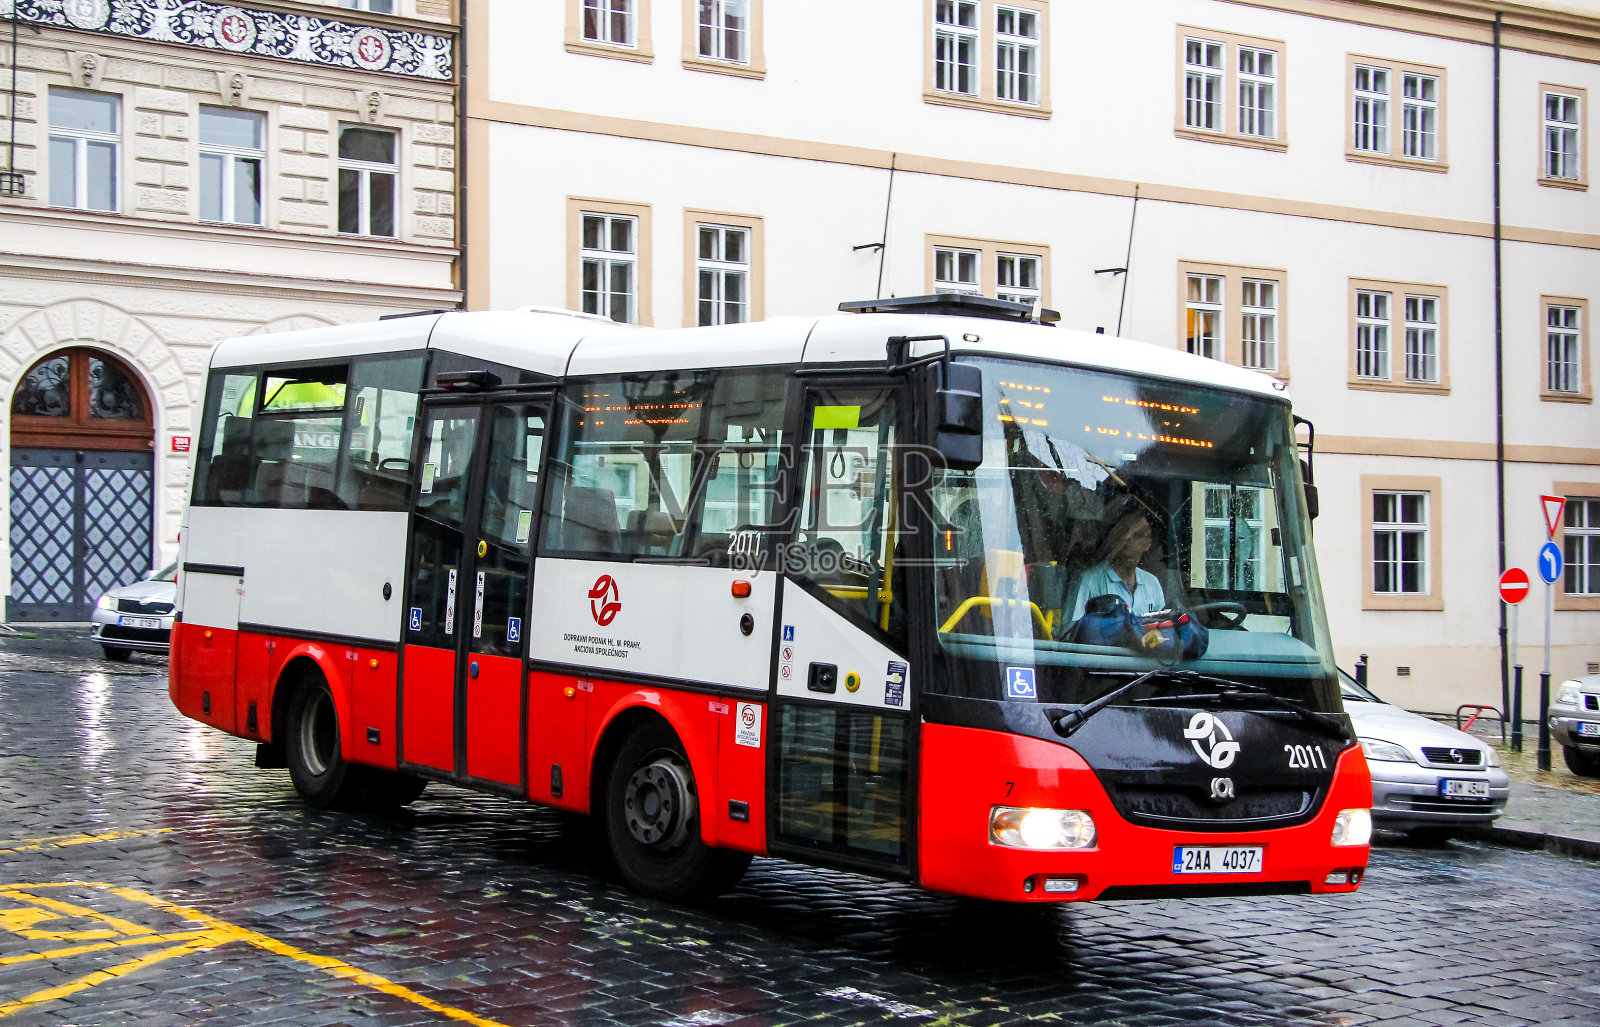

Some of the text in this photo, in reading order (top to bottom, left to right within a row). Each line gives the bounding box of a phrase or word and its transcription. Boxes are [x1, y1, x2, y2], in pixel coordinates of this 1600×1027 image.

[727, 531, 762, 556] 2011
[1284, 744, 1327, 769] 2011
[1005, 781, 1015, 798] 7
[1185, 850, 1211, 870] 2AA
[1222, 849, 1256, 870] 4037
